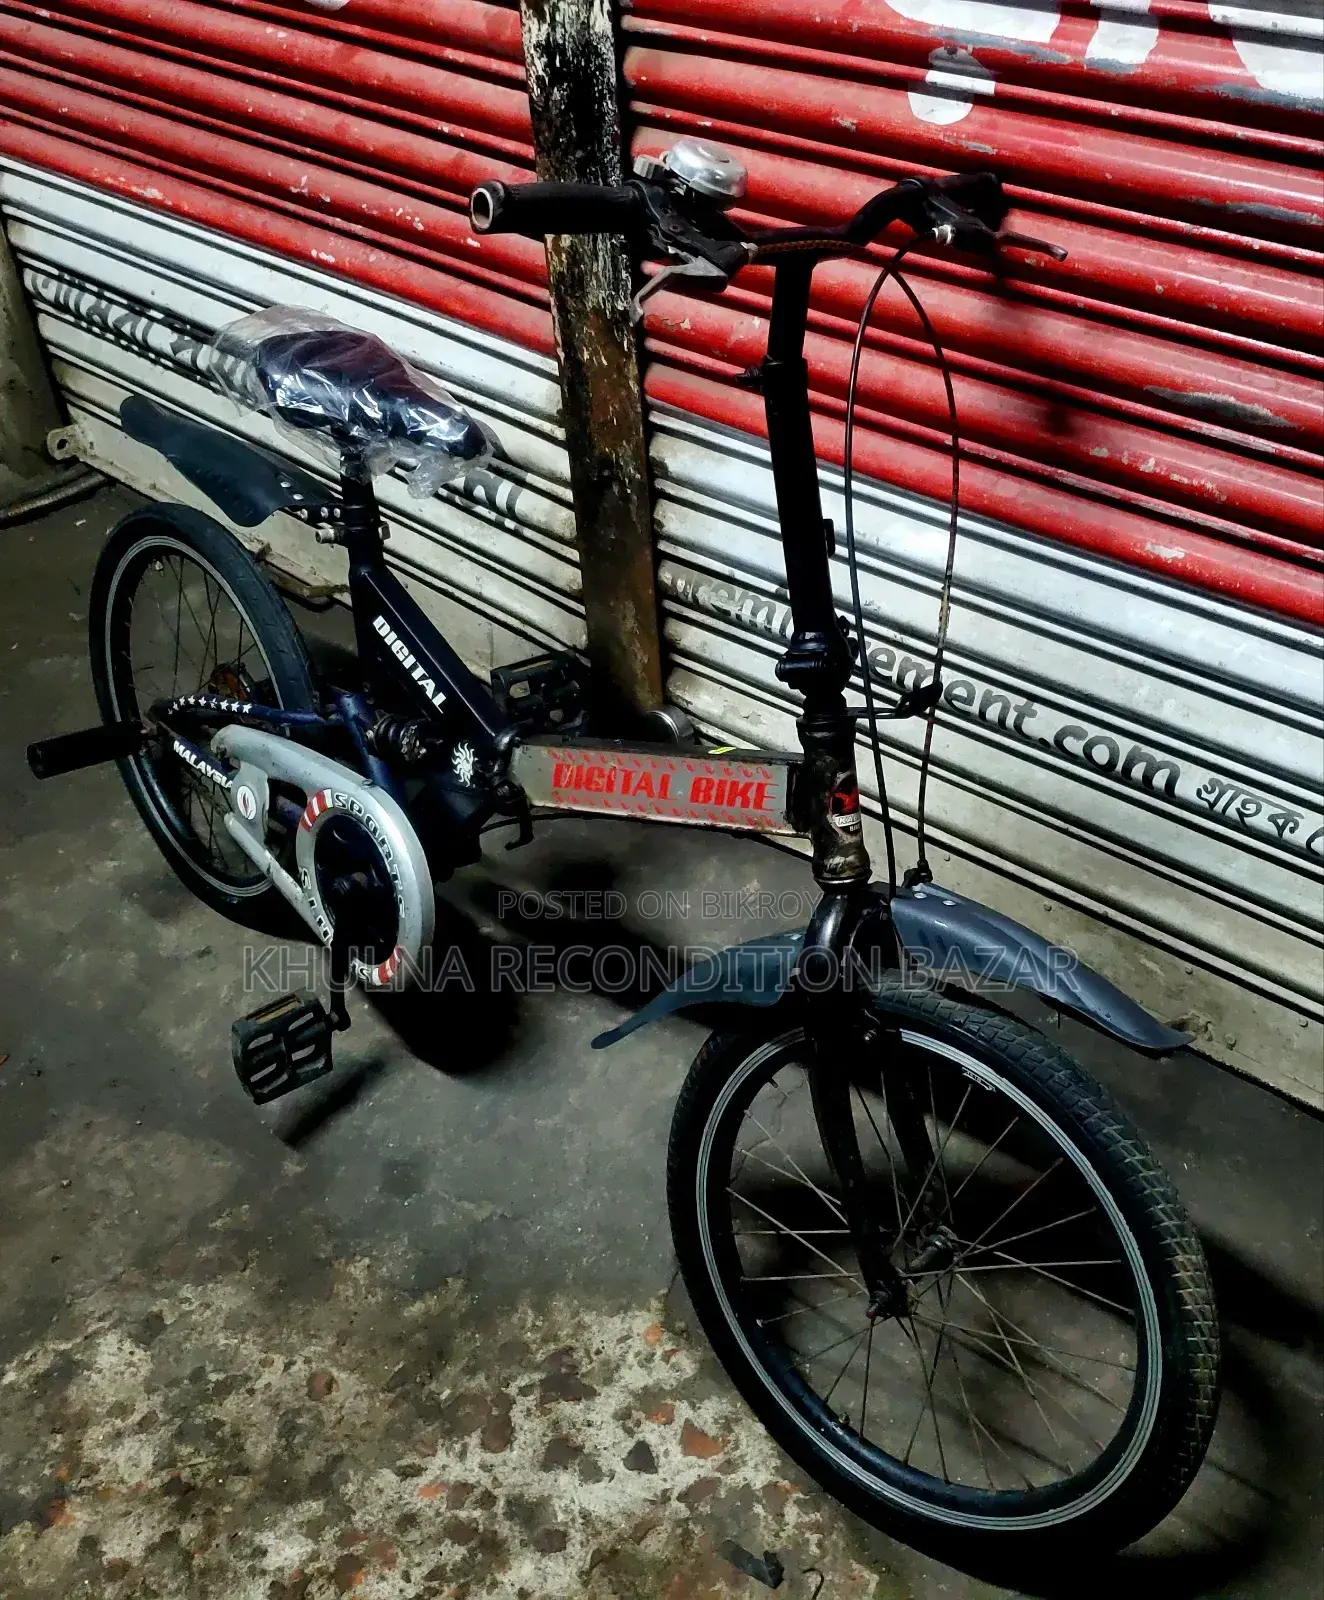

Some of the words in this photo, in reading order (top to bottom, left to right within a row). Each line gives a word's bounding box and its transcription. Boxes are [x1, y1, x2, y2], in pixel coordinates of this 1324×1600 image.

[372, 615, 447, 714] DIGITAL
[551, 761, 679, 802] DIGITAL
[688, 774, 780, 812] BIKE
